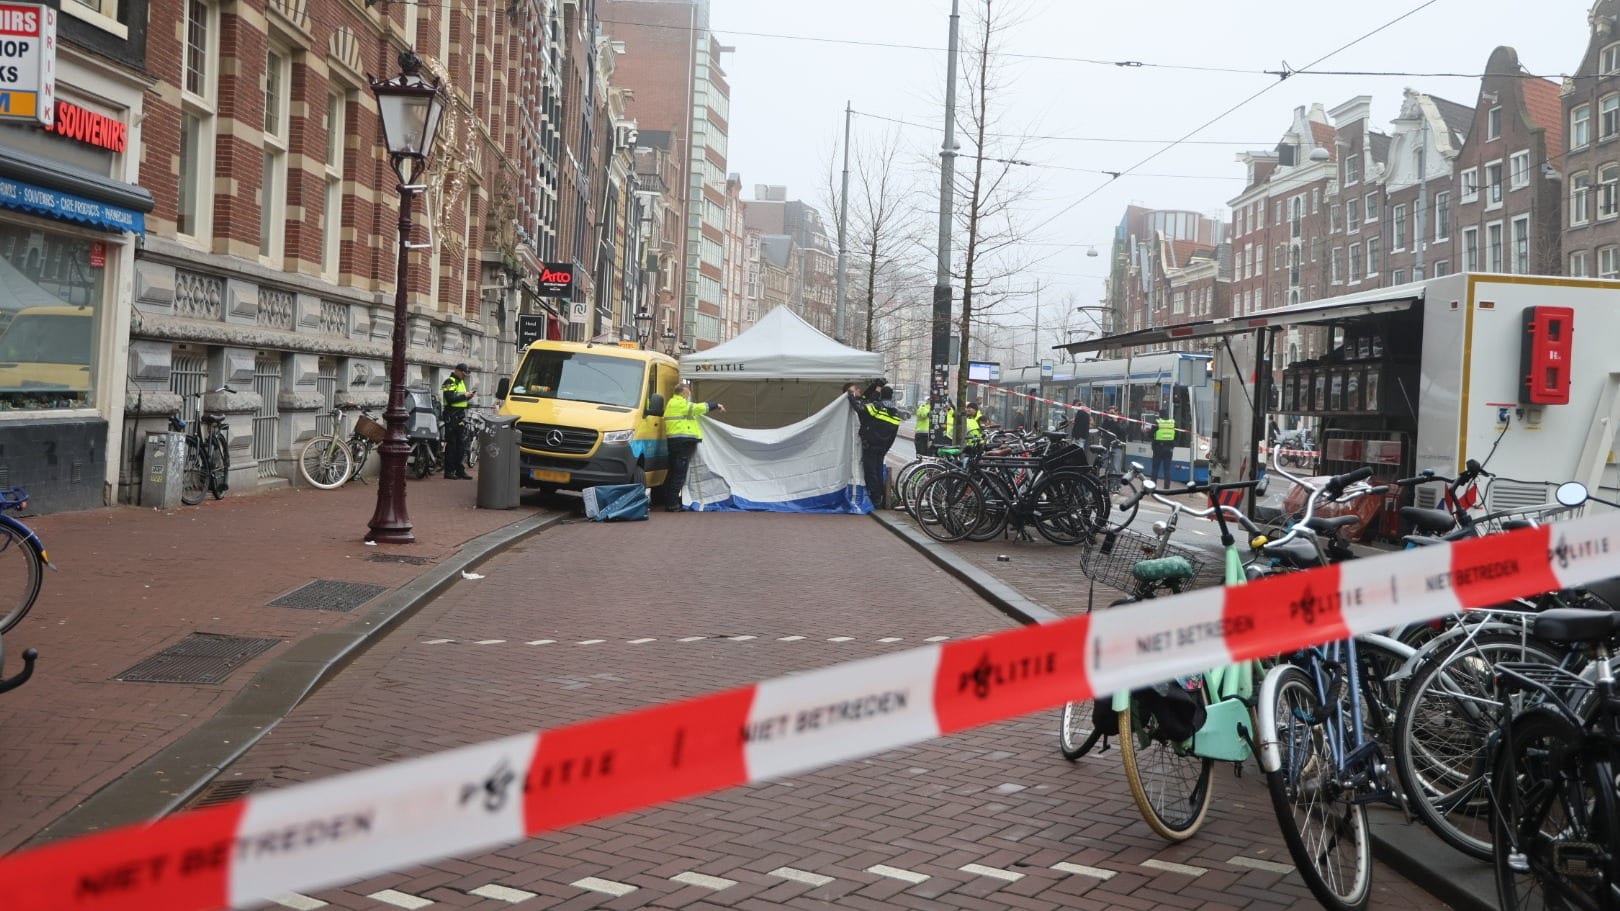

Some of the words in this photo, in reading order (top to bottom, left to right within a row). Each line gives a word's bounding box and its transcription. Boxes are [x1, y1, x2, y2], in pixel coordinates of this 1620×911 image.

[0, 9, 37, 32] IRS
[0, 41, 29, 57] OP
[58, 101, 128, 153] SOUVENIRS
[1426, 574, 1452, 592] NIET
[1455, 560, 1519, 587] BETREDEN
[1137, 632, 1173, 655] NIET
[1175, 614, 1256, 647] BETREDEN
[738, 717, 791, 746] NIET
[795, 689, 909, 734] BETREDEN
[75, 853, 170, 900] NIET
[179, 808, 375, 879] BETREDEN
